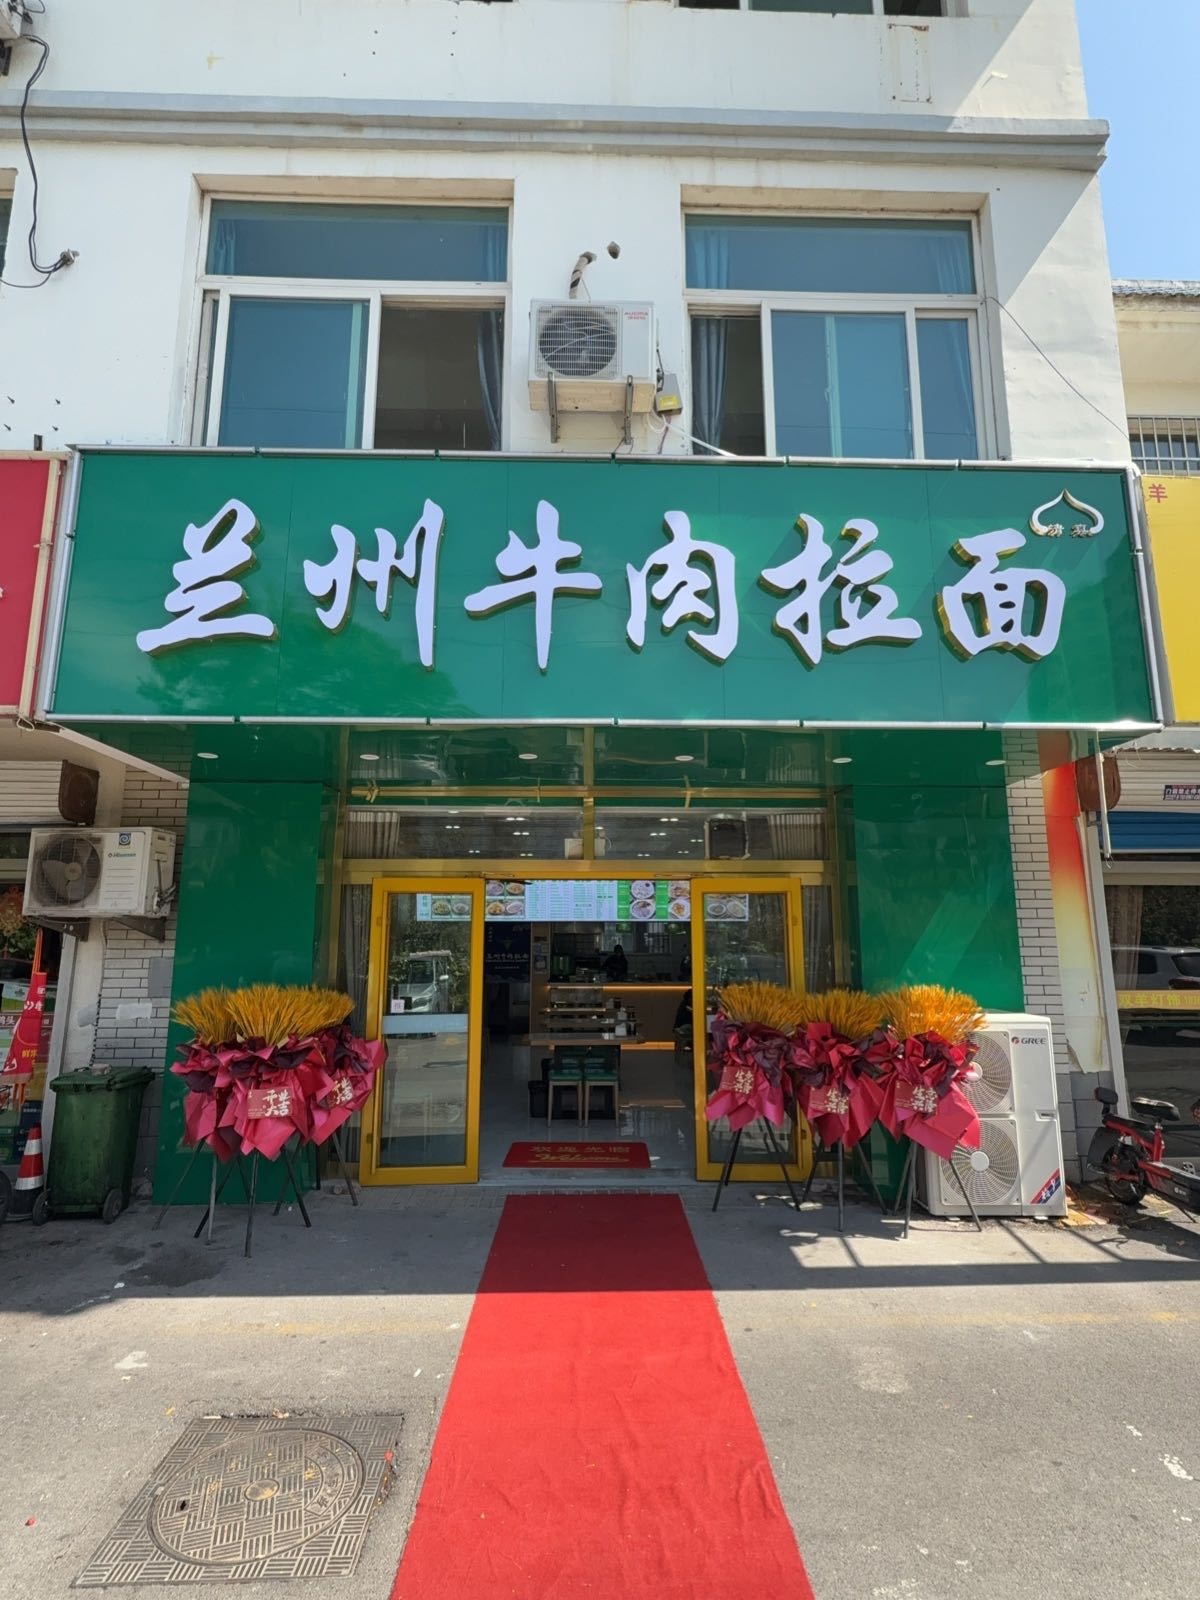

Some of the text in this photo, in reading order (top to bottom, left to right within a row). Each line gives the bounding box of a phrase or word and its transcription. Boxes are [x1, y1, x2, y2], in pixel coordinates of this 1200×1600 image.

[1148, 484, 1168, 503] 羊
[136, 498, 1067, 672] 兰州牛肉拉面
